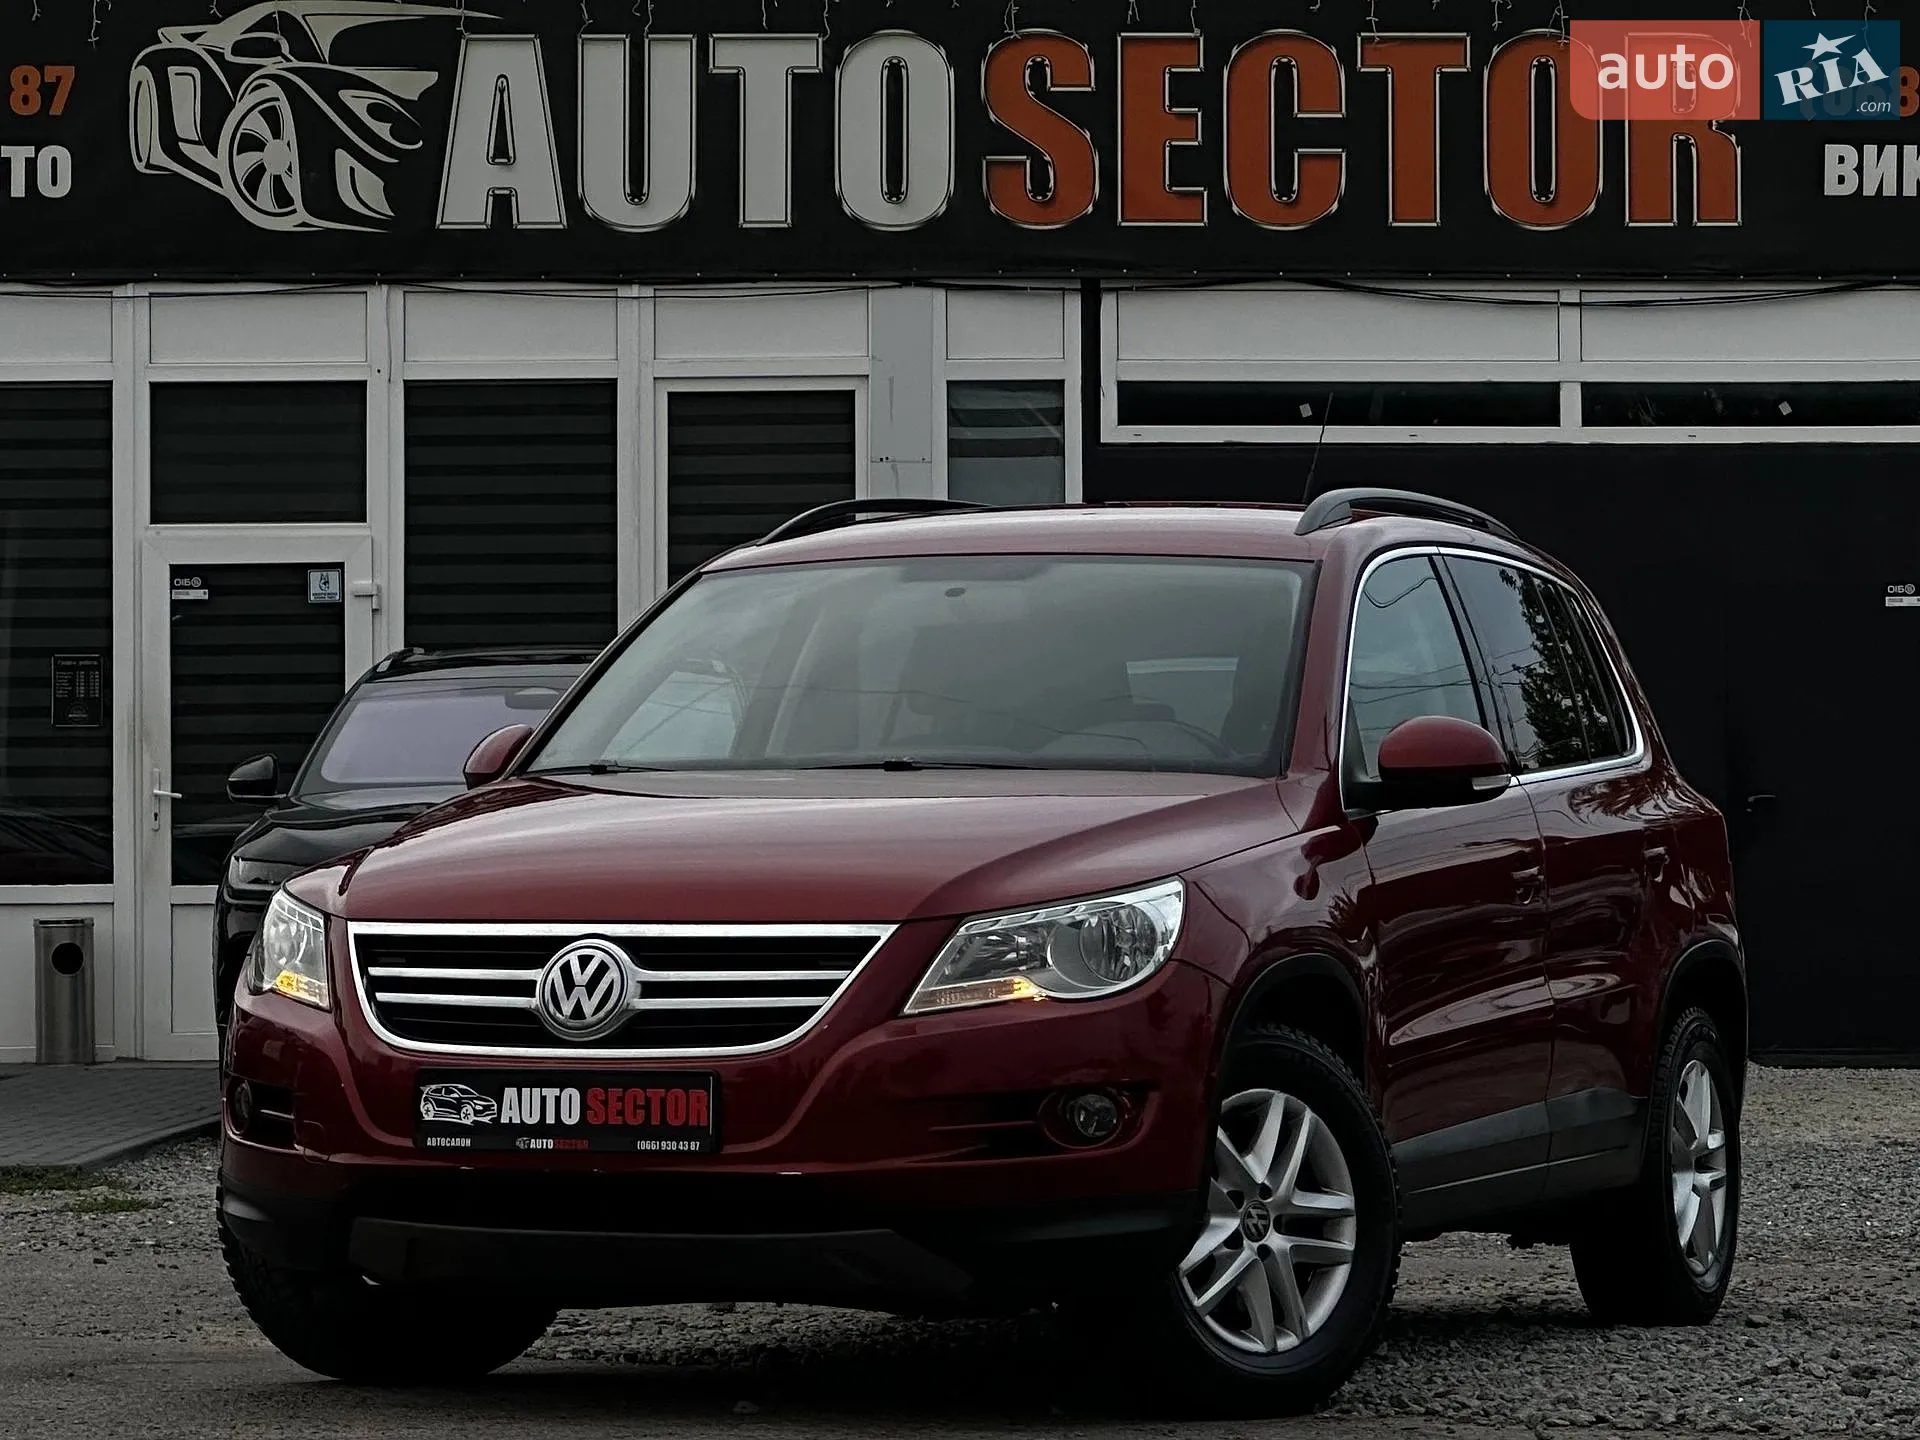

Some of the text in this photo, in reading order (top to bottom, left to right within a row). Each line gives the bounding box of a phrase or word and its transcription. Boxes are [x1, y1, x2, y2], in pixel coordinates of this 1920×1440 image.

[9, 64, 76, 117] 87
[500, 1087, 709, 1126] AUTO SECTOR
[678, 1141, 689, 1151] 43
